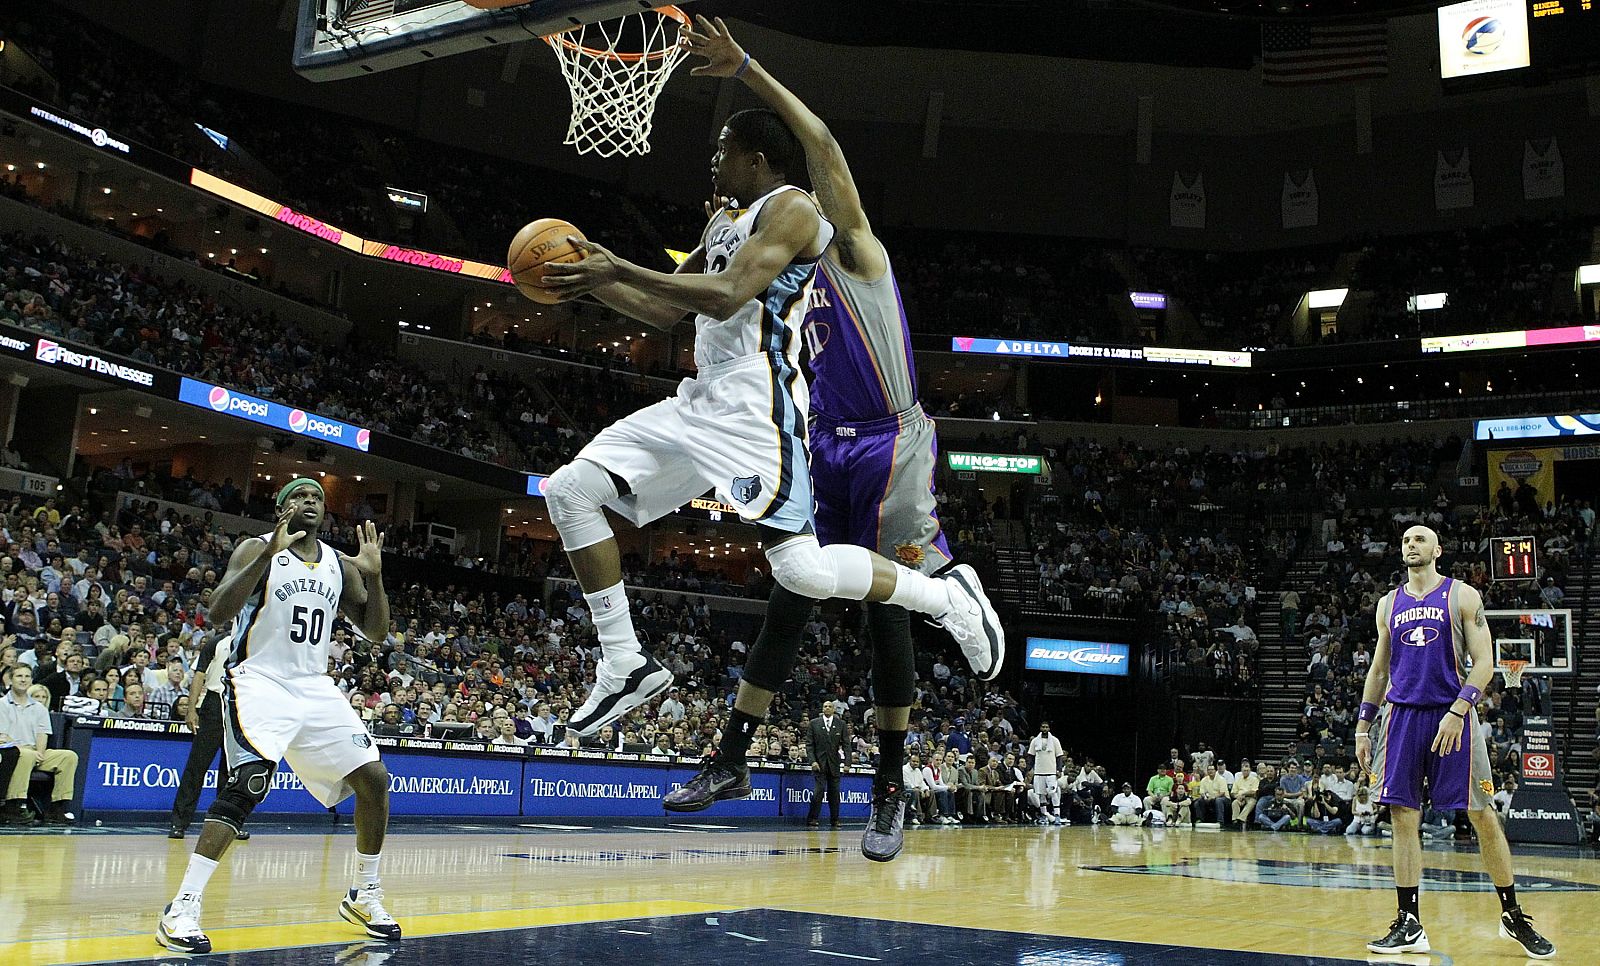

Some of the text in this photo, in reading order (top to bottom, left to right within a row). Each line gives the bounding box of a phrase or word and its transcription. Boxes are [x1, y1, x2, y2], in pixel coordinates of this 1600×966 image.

[31, 106, 130, 153] INTERNATIONAL PAPER
[277, 206, 342, 244] AutoZone
[383, 245, 463, 273] AutoZone
[1012, 342, 1061, 355] DELTA
[57, 346, 154, 386] FIRST TENNESSEE
[229, 397, 269, 417] pepsi
[307, 419, 343, 438] pepsi
[30, 479, 46, 491] 105
[691, 498, 737, 513] GRIZZLIE
[1503, 541, 1531, 555] 2:14
[1509, 554, 1529, 575] 11
[289, 605, 325, 646] 50
[1394, 606, 1445, 629] PHOENIX
[1410, 626, 1426, 647] 4
[1030, 648, 1126, 664] BUD LIGHT
[114, 719, 164, 732] McDonald's
[1523, 729, 1552, 738] Memphis
[407, 739, 442, 750] McDonald's
[452, 741, 485, 752] McDonald's
[1526, 743, 1550, 751] Dealers
[1528, 736, 1548, 744] Toyota
[98, 762, 140, 788] THE
[1524, 769, 1553, 777] TOYOTA
[470, 776, 514, 796] APPEAL
[530, 778, 560, 797] THE
[556, 779, 629, 798] COMMERCIAL
[625, 782, 662, 799] APPEAL
[786, 787, 803, 803] THE
